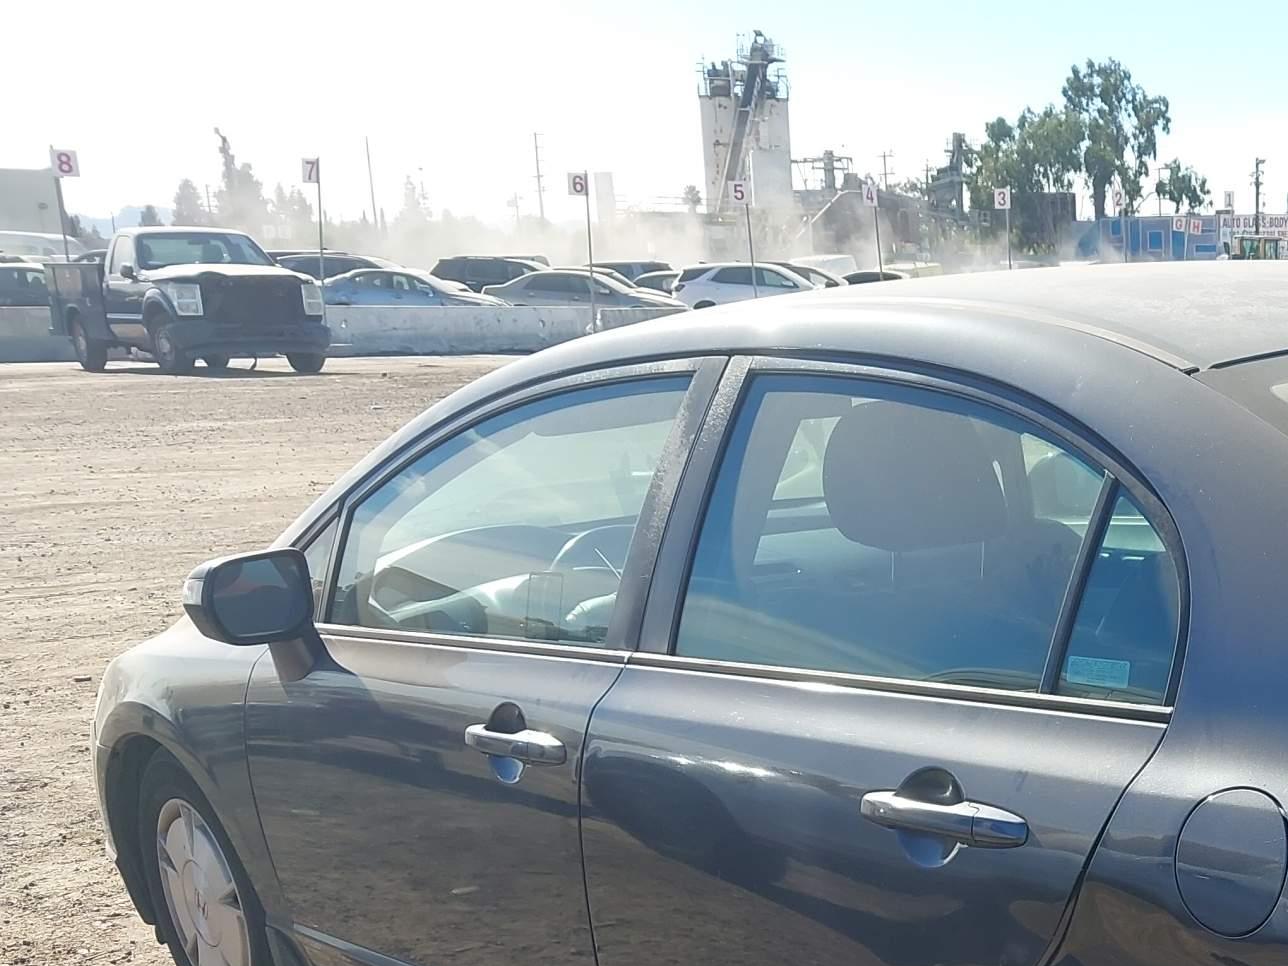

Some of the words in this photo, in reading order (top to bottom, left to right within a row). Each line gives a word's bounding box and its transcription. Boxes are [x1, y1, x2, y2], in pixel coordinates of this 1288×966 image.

[56, 152, 73, 173] 8
[305, 160, 316, 180] 7
[572, 175, 585, 193] 6
[733, 183, 745, 201] 5
[865, 186, 875, 203] 4
[997, 191, 1007, 207] 3
[1115, 192, 1123, 207] 2
[1225, 192, 1232, 206] 1
[1175, 218, 1183, 230] G
[1192, 221, 1200, 233] H
